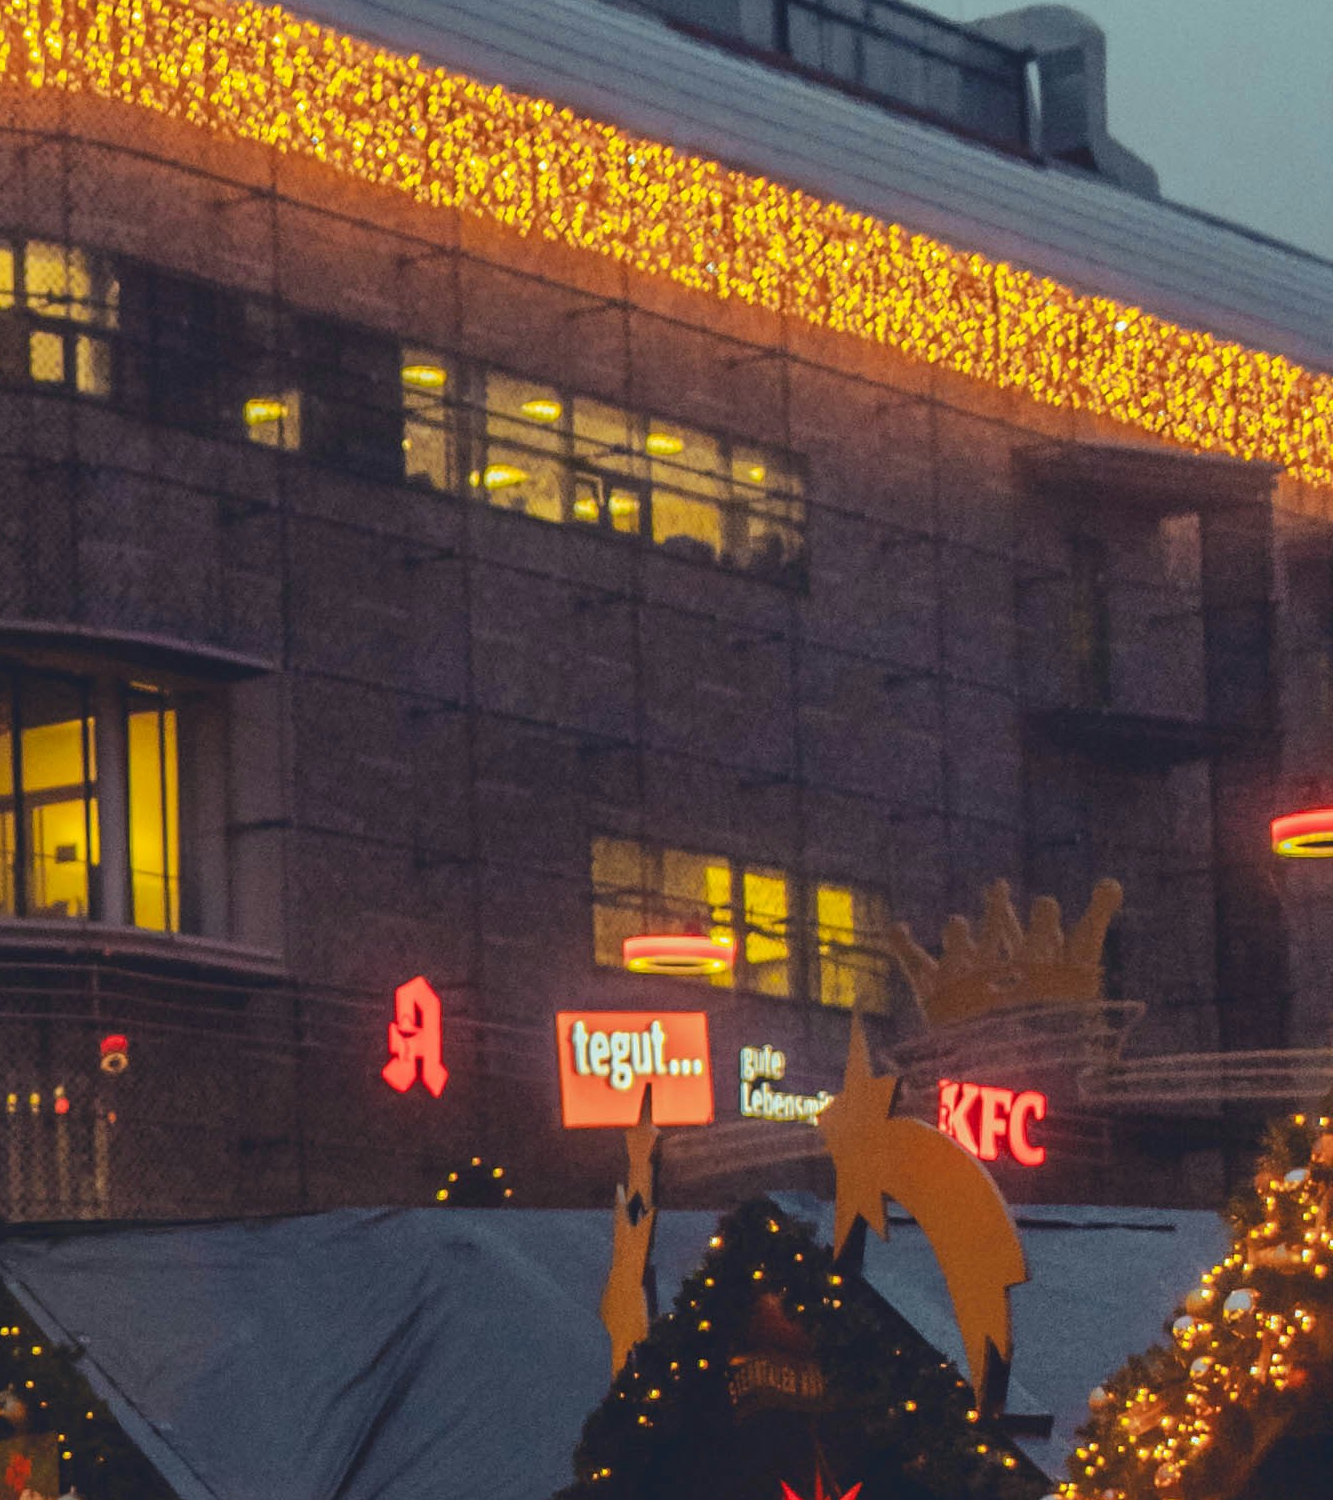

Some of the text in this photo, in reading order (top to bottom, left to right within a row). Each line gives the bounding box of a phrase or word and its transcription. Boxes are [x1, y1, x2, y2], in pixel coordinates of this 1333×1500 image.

[572, 1019, 704, 1091] tegut...
[740, 1044, 785, 1083] gute
[938, 1079, 1047, 1167] KFC
